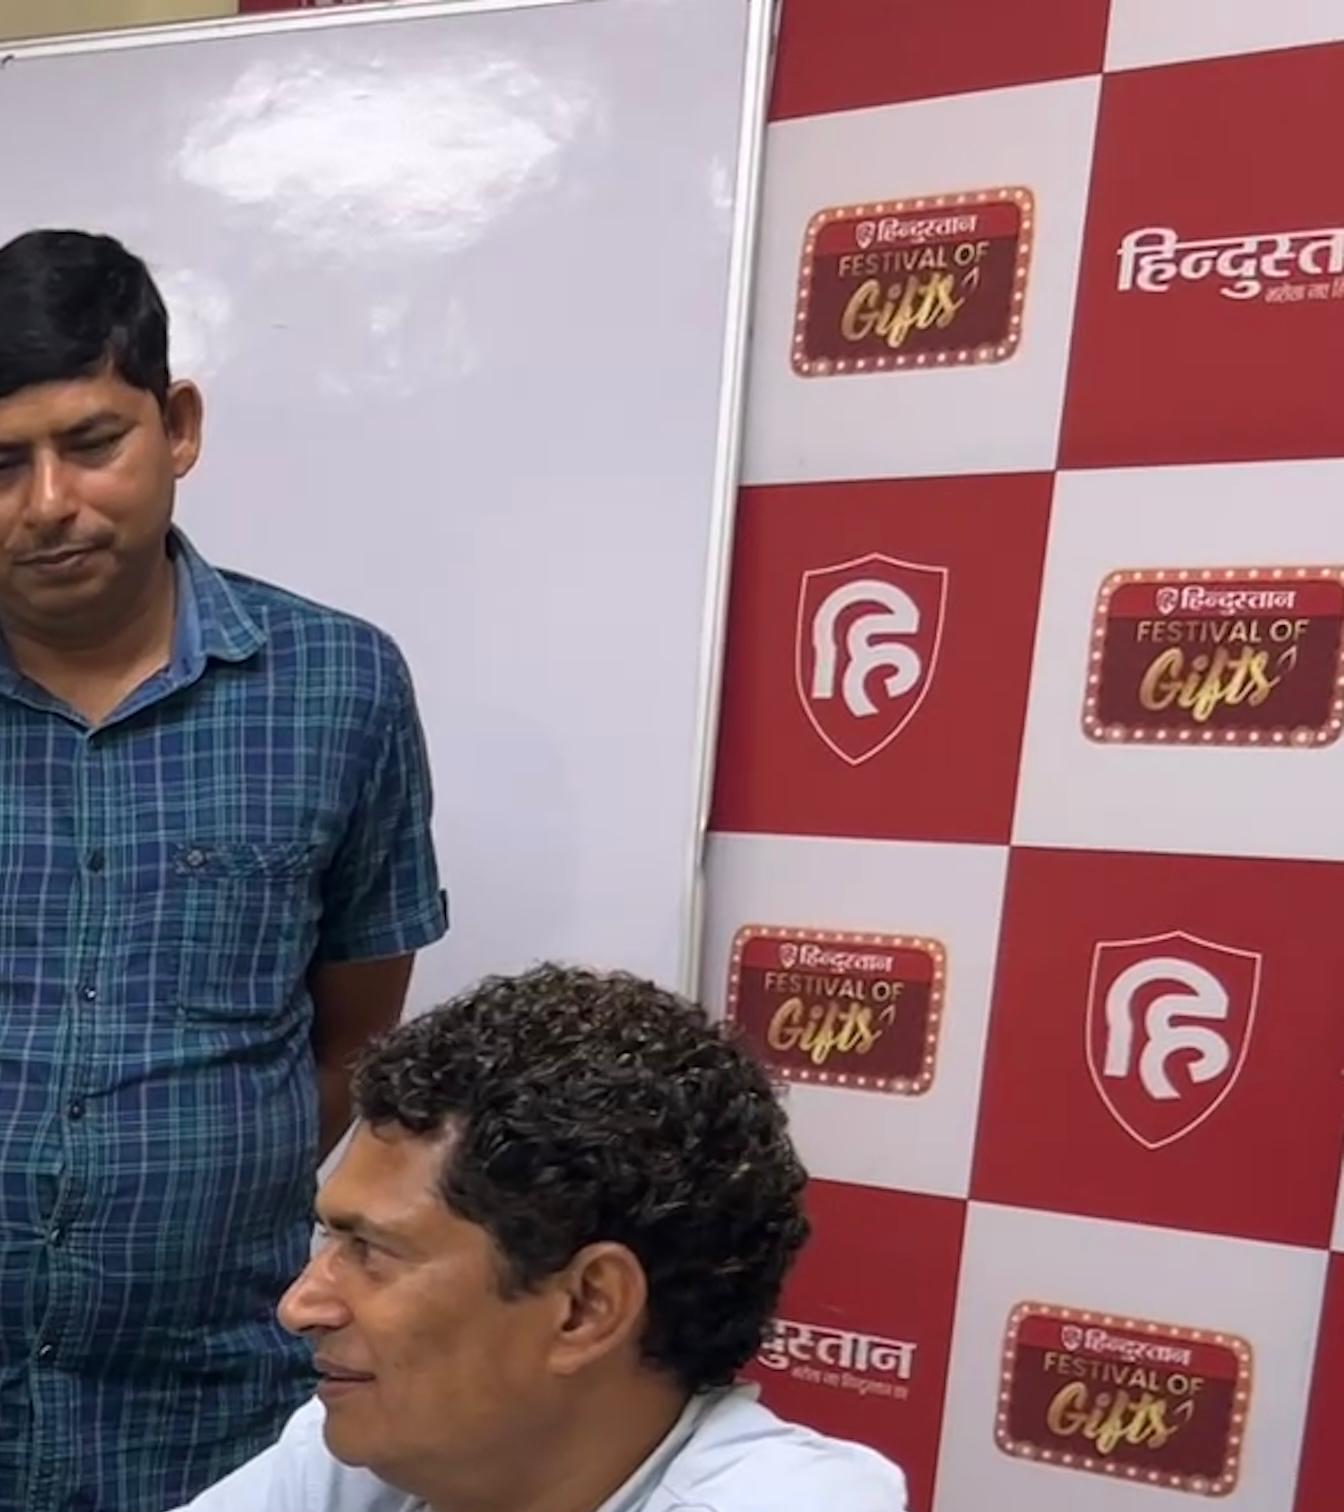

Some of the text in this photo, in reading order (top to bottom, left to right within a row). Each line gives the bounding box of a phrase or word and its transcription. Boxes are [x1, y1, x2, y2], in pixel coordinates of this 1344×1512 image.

[838, 241, 990, 278] FESTIVAL OF
[841, 272, 966, 349] Gifts
[1137, 618, 1310, 644] FESTIVAL OF
[1139, 646, 1281, 723] Gifts
[764, 971, 905, 1001] FESTIVAL OF
[767, 996, 883, 1065] Gifts
[1043, 1351, 1204, 1397] FESTIVAL OF
[1046, 1381, 1179, 1455] Gifts
